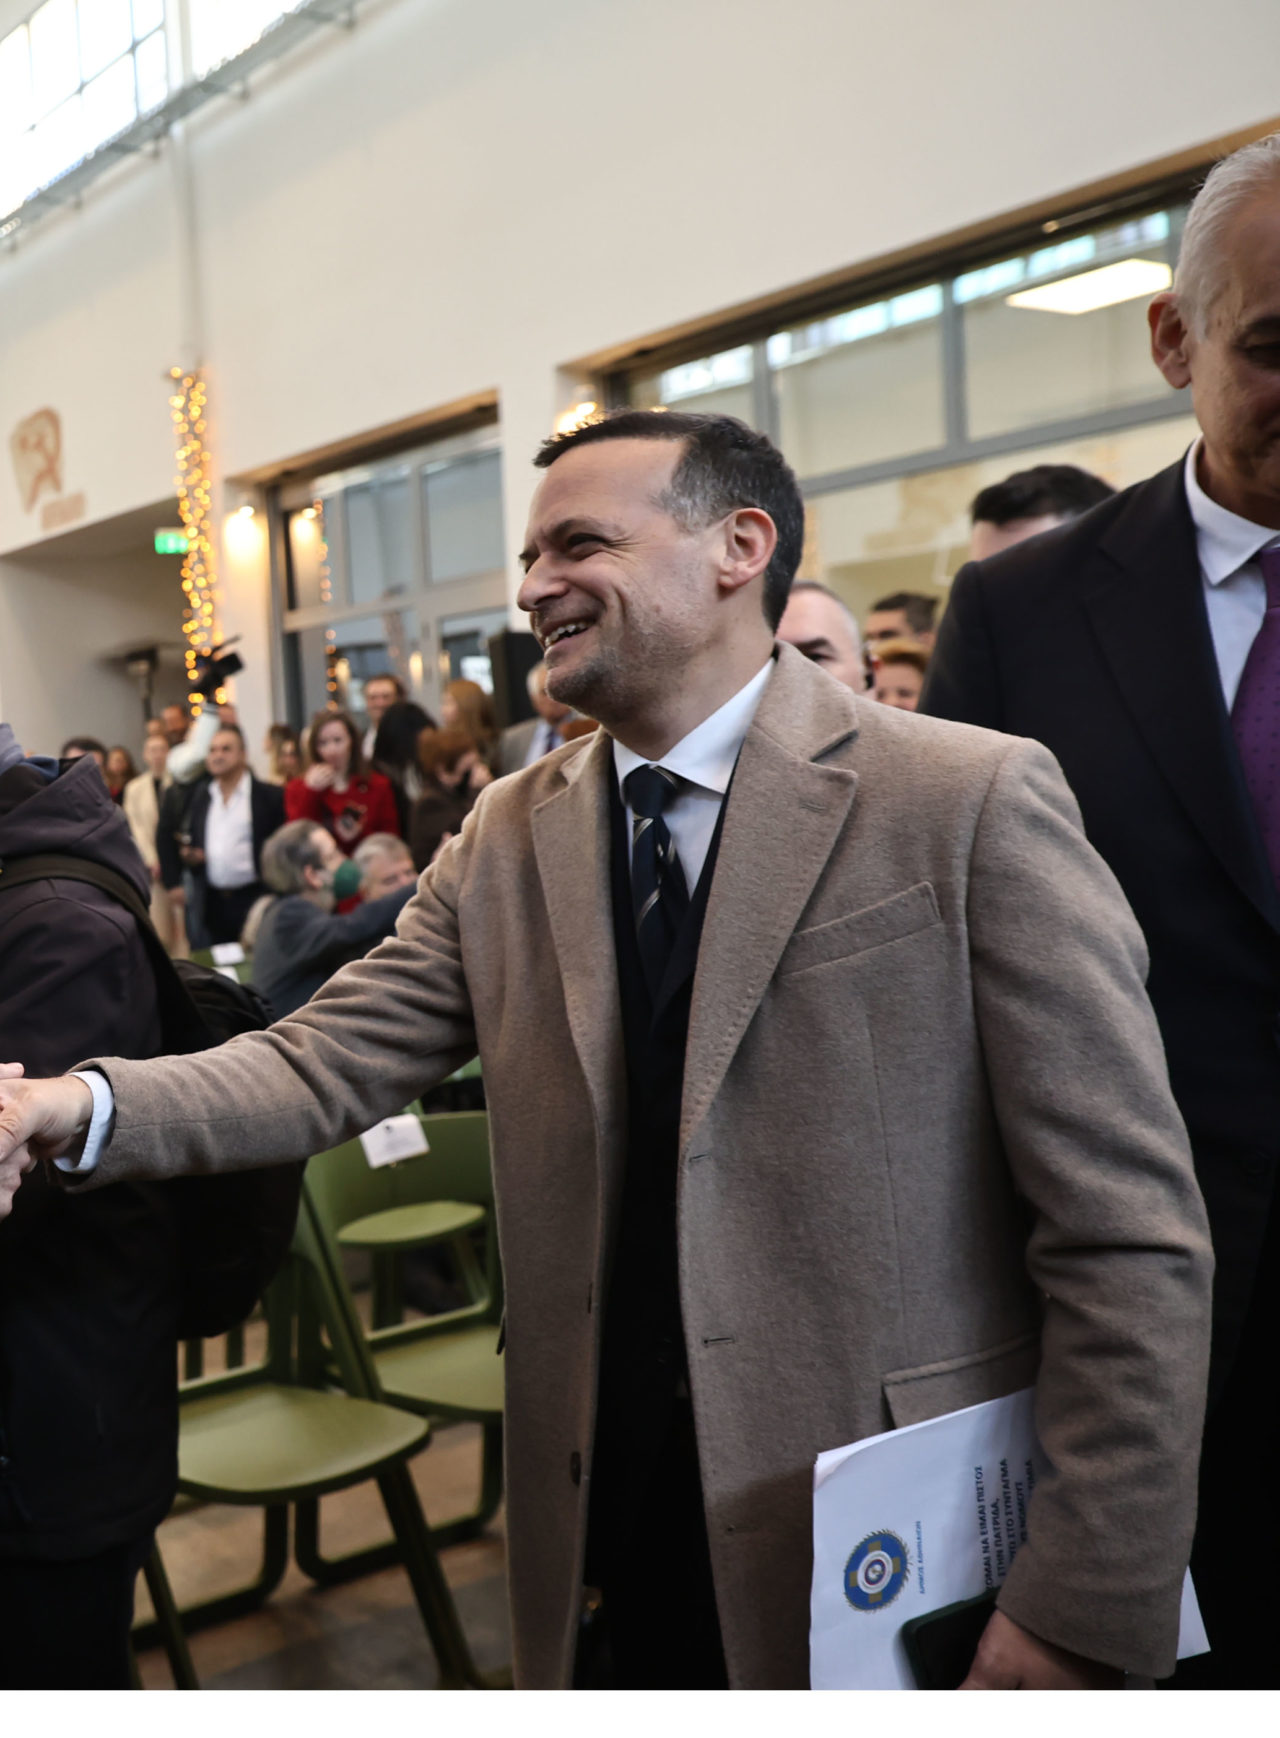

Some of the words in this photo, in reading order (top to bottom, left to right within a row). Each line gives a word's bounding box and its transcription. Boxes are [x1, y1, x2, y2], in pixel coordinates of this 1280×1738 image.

[974, 1466, 985, 1503] ΠΙΣΤΟΣ
[1000, 1458, 1013, 1516] ΣΥΝΤΑΓΜΑ
[977, 1504, 989, 1535] ΕΙΜΑΙ
[991, 1498, 1003, 1547] ΠΑΤΡΙΔΑ,
[1005, 1518, 1016, 1539] ΣΤΟ
[981, 1537, 990, 1553] ΝΑ
[996, 1549, 1007, 1577] ΣΤΗΝ
